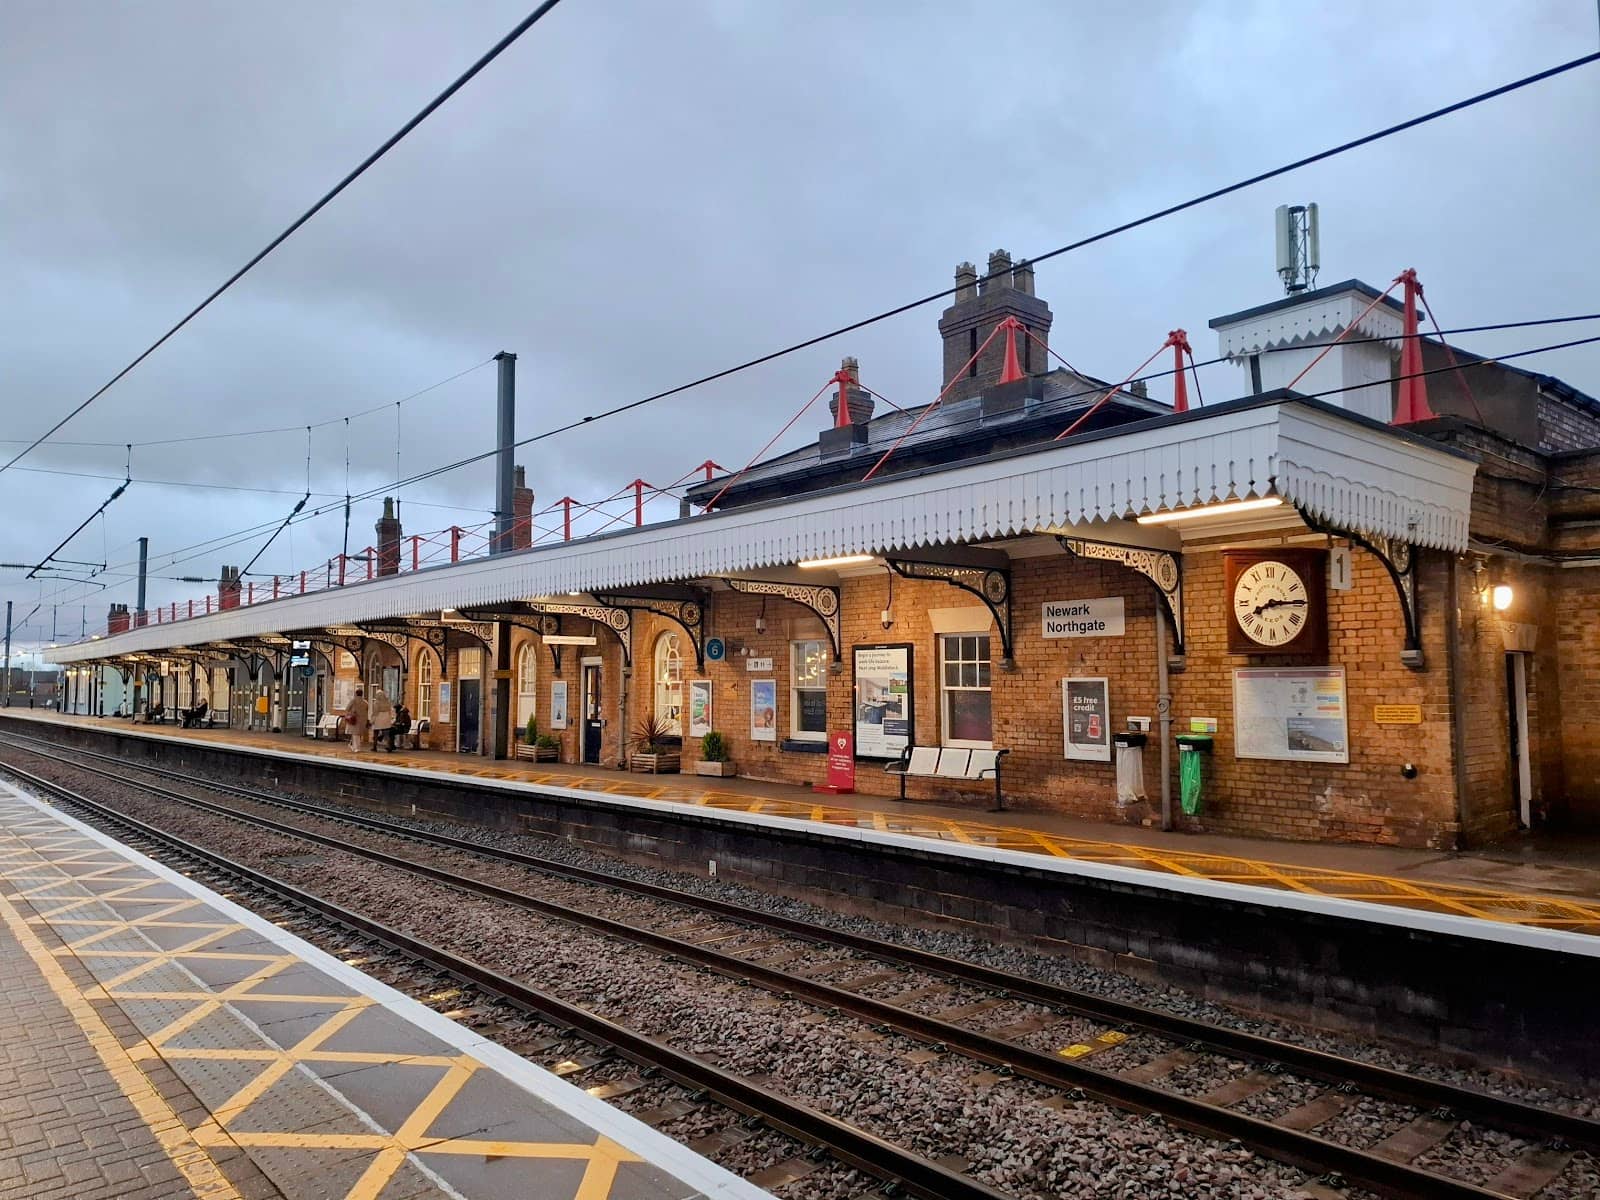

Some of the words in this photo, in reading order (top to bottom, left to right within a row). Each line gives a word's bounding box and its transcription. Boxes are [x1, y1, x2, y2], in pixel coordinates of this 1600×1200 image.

[1266, 567, 1275, 578] XII
[1336, 554, 1344, 583] 1
[1250, 571, 1262, 583] XI
[1280, 571, 1287, 582] I
[1289, 583, 1299, 593] II
[1239, 599, 1249, 607] IX
[1046, 604, 1090, 617] Newark
[1047, 620, 1106, 634] Northgate
[1282, 625, 1290, 636] V
[711, 645, 719, 656] 6
[1073, 696, 1083, 704] £5
[1083, 696, 1098, 704] free
[1073, 704, 1095, 712] credit
